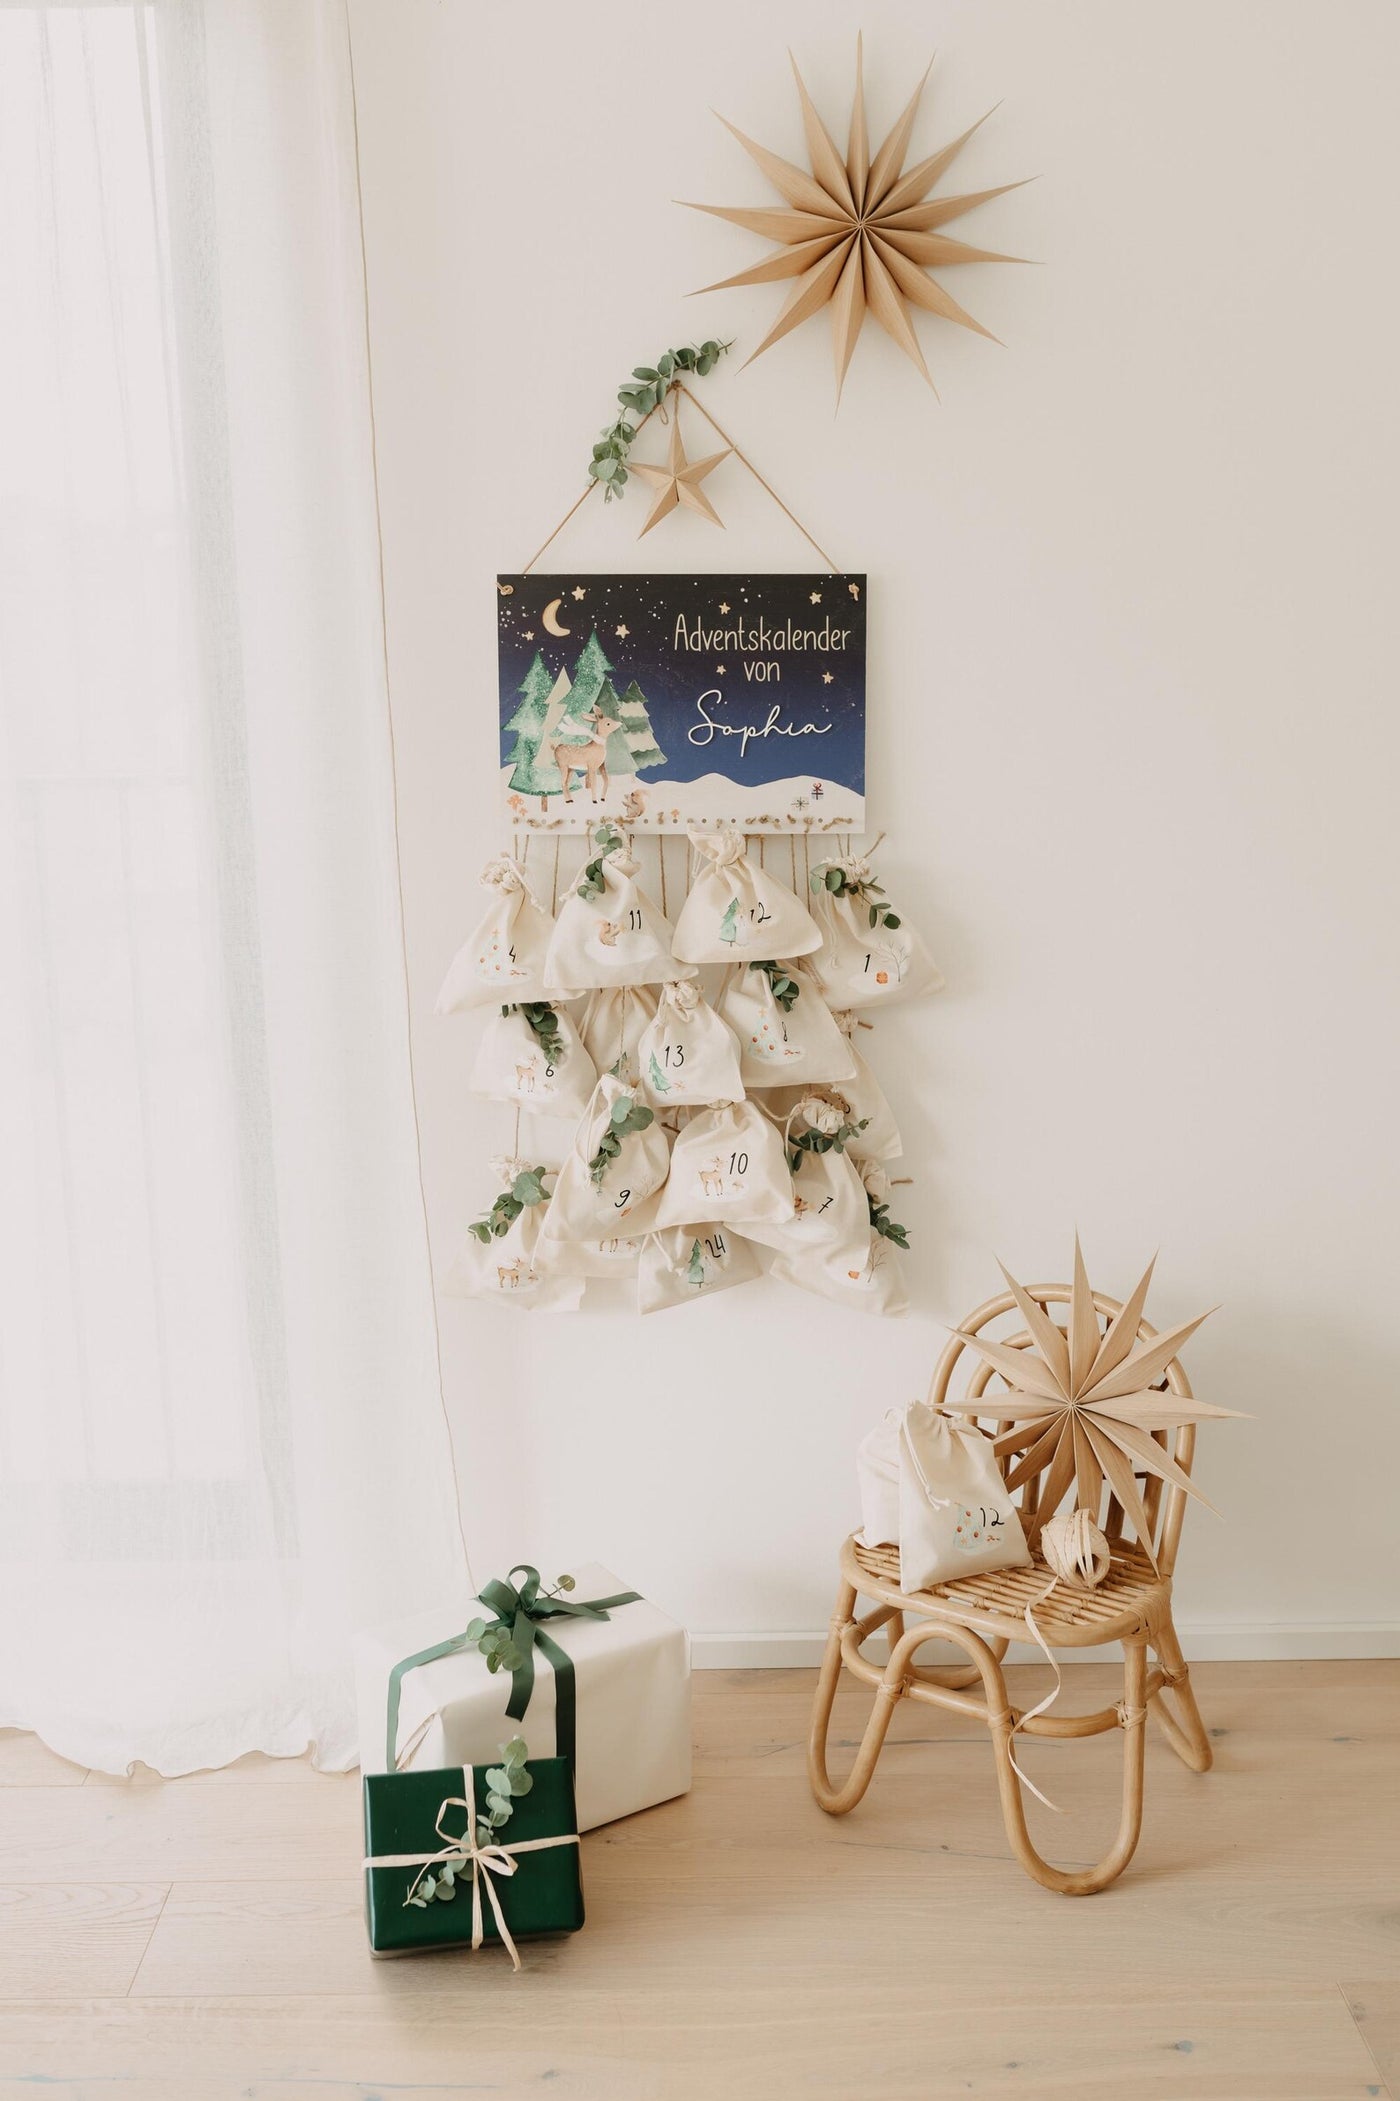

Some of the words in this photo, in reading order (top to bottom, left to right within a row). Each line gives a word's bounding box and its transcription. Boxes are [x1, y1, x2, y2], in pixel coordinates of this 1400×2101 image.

[675, 613, 851, 651] Adventskalender
[743, 661, 780, 682] von
[687, 689, 833, 758] Sophia
[629, 909, 641, 930] 11
[665, 1045, 685, 1067] 13
[545, 1064, 555, 1077] 6
[729, 1153, 749, 1174] 10
[614, 1189, 631, 1208] 9
[818, 1196, 834, 1214] 7
[704, 1234, 726, 1258] 24
[979, 1507, 1005, 1528] 12
